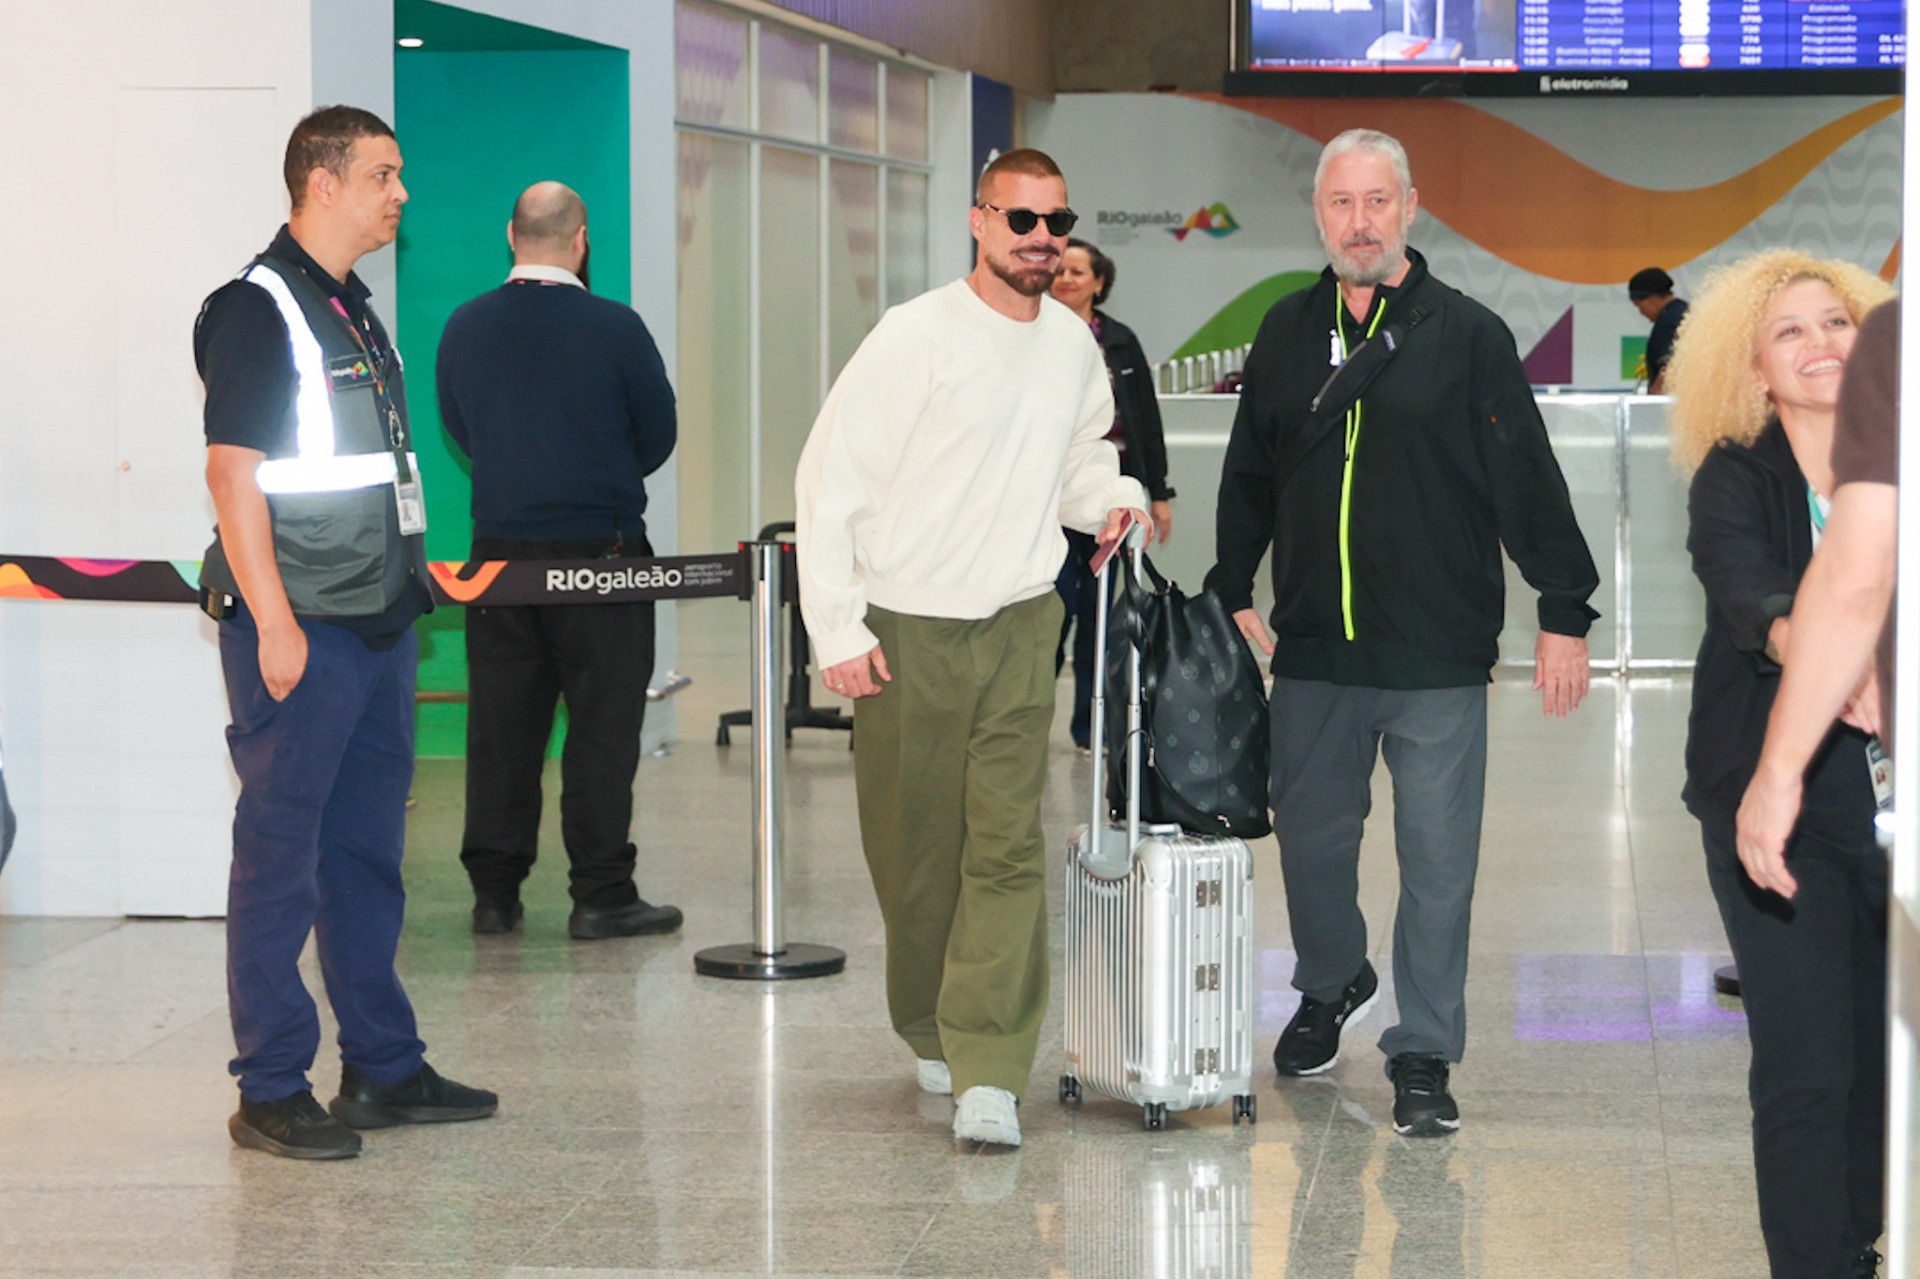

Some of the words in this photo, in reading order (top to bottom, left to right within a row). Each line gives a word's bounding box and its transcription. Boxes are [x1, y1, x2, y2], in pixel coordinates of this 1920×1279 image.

[1585, 6, 1623, 16] Santiago
[1801, 15, 1857, 24] Programado
[1801, 25, 1857, 34] Programado
[1585, 37, 1623, 46] Santiago
[1801, 35, 1857, 44] Programado
[1556, 47, 1588, 56] Buenos
[1590, 47, 1612, 56] Aires
[1801, 45, 1857, 55] Programado
[1556, 57, 1588, 66] Buenos
[1590, 57, 1612, 66] Aires
[1801, 56, 1857, 65] Programado
[684, 562, 723, 572] aeroporto
[684, 568, 734, 578] internacional
[546, 565, 682, 595] RIOgaleão
[684, 578, 699, 586] tom
[700, 577, 723, 587] jobim
